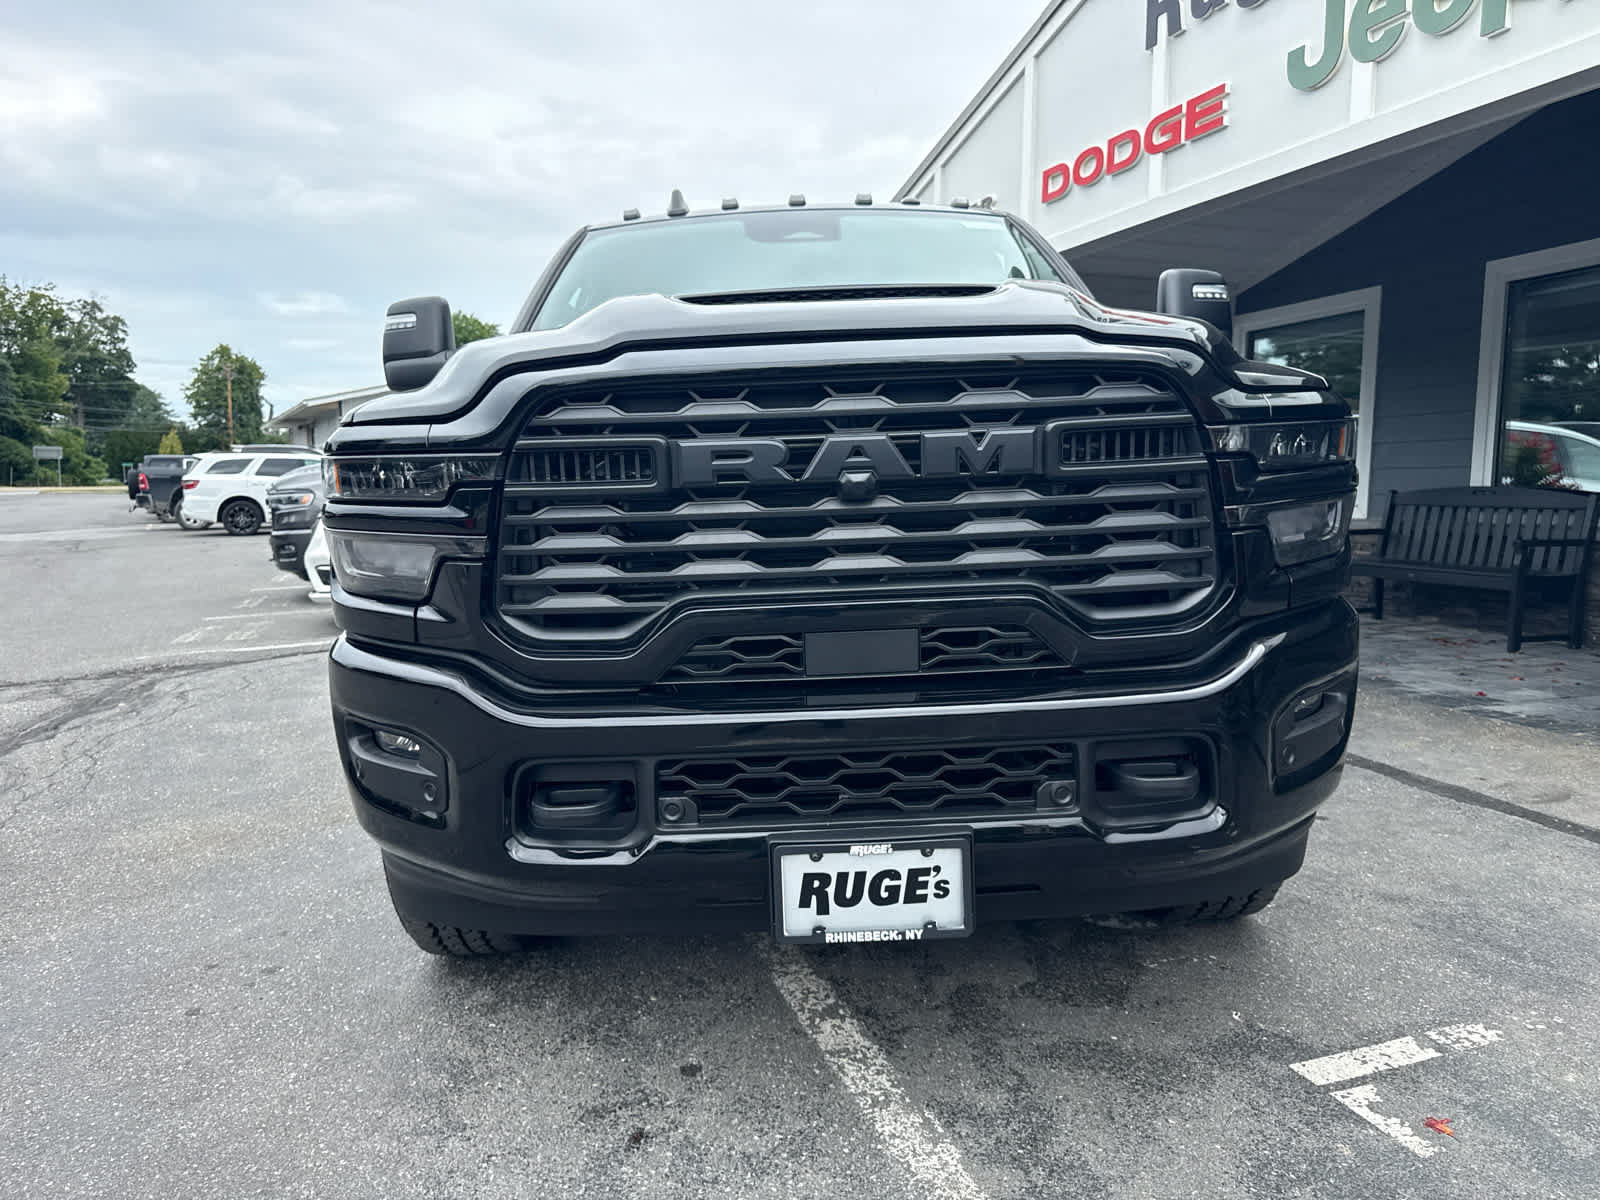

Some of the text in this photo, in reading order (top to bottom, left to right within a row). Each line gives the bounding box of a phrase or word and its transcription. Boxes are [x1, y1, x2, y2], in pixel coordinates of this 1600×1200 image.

[1041, 83, 1228, 205] DODGE
[677, 426, 1037, 487] RAM
[798, 865, 950, 916] RUGE's
[825, 929, 924, 943] RHINEBECK, NY
